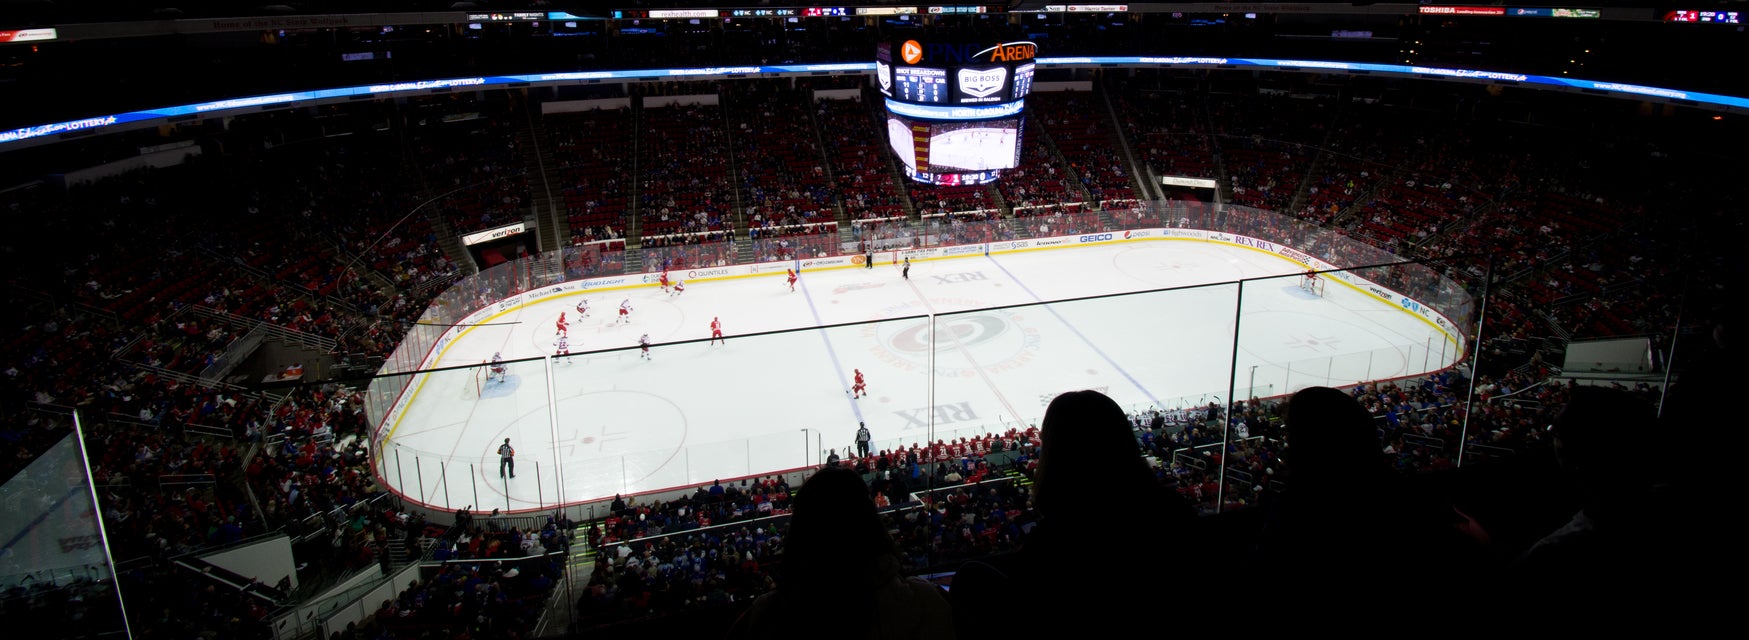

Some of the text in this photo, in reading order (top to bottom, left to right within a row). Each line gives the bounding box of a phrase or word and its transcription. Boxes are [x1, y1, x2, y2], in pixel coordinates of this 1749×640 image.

[1419, 6, 1456, 14] TOSHIBA
[990, 43, 1035, 62] ARENA
[66, 117, 105, 130] LOTTERY
[980, 172, 985, 180] 0
[491, 226, 520, 238] verizon
[1080, 233, 1112, 243] GEICO
[1235, 236, 1274, 252] REX REX
[698, 269, 728, 277] QUINTILES
[929, 271, 990, 285] REX
[602, 279, 625, 287] LIGHT
[528, 288, 553, 299] Michael
[1369, 287, 1392, 300] verizon
[1419, 306, 1430, 317] NC
[892, 401, 983, 430] REX
